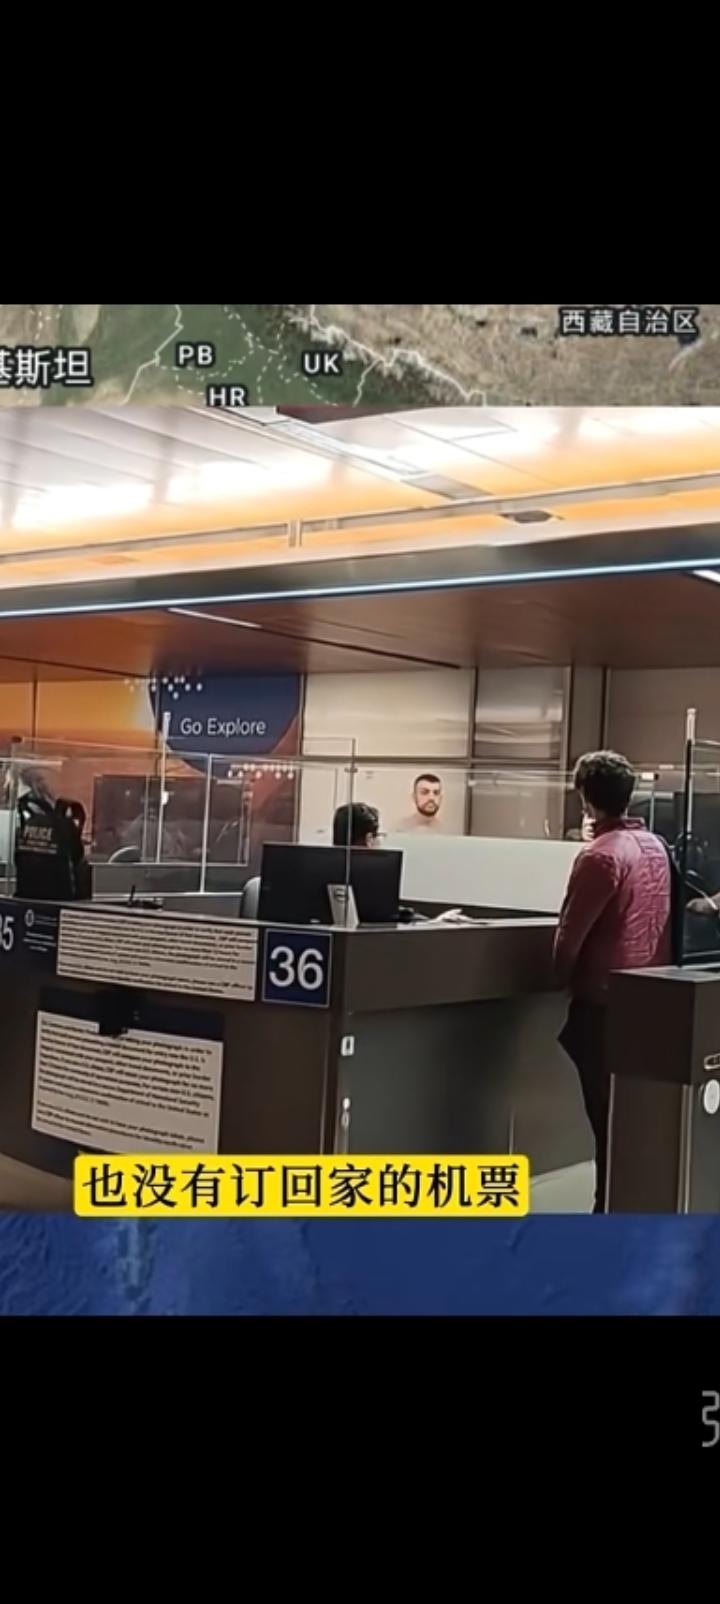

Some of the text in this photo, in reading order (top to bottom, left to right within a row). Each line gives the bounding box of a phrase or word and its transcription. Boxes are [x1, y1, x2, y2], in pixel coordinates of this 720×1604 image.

[180, 717, 266, 738] Go Explore
[268, 945, 324, 990] 36
